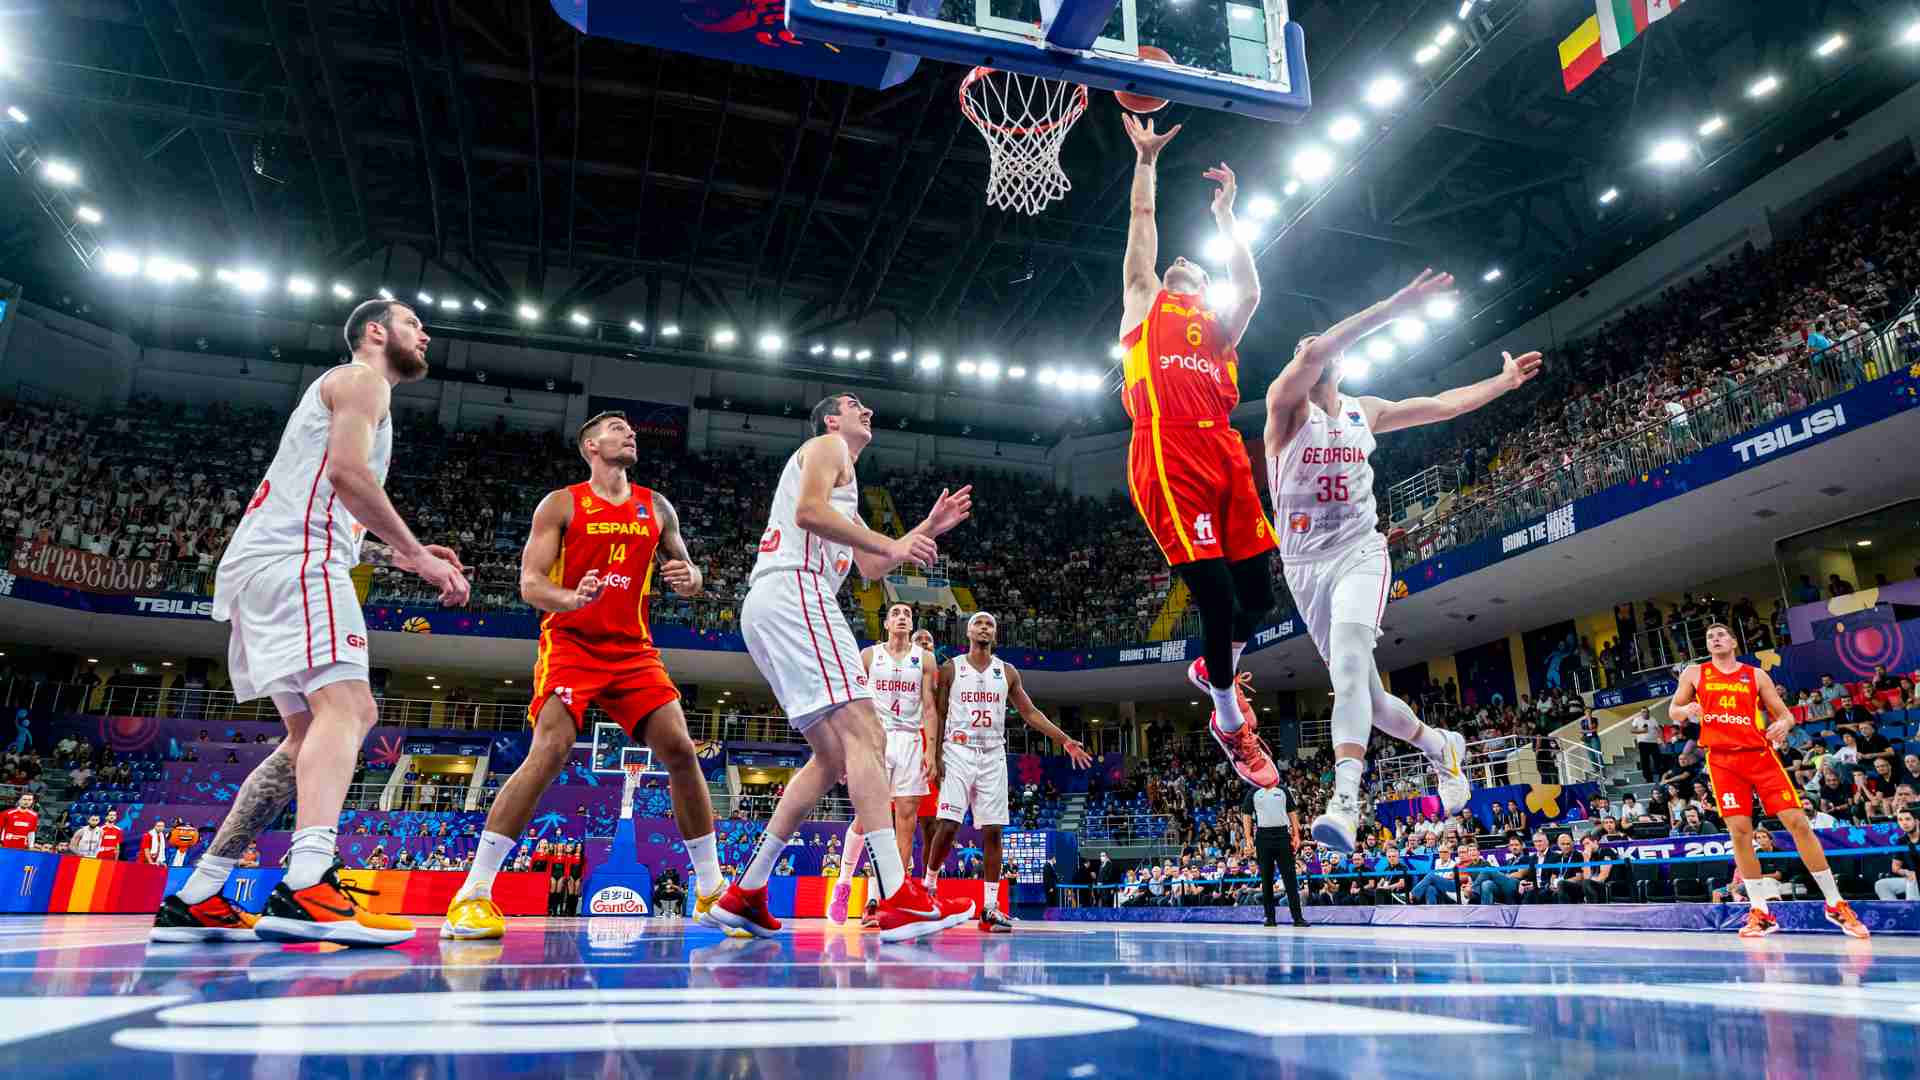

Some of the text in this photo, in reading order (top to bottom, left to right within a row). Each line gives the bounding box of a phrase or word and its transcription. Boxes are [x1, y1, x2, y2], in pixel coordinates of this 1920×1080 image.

[1186, 322, 1202, 347] 6
[1732, 403, 1847, 463] TBILISI
[1302, 447, 1366, 464] GEORGIA
[1316, 475, 1350, 503] 35
[586, 522, 650, 537] ESPAÑA
[1502, 503, 1576, 553] BRING THE NOISE
[607, 543, 627, 565] 14
[134, 597, 213, 616] TBILIS
[1254, 619, 1294, 646] TBILISI
[1119, 640, 1187, 662] BRING THE NOISE
[876, 679, 918, 693] GEORGIA
[1705, 682, 1750, 692] ESPAÑA
[960, 691, 1001, 704] GEORGIA
[1719, 695, 1737, 709] 44
[890, 699, 901, 717] 4
[971, 709, 993, 728] 25
[1703, 712, 1752, 726] endesa
[1684, 837, 1736, 858] 202
